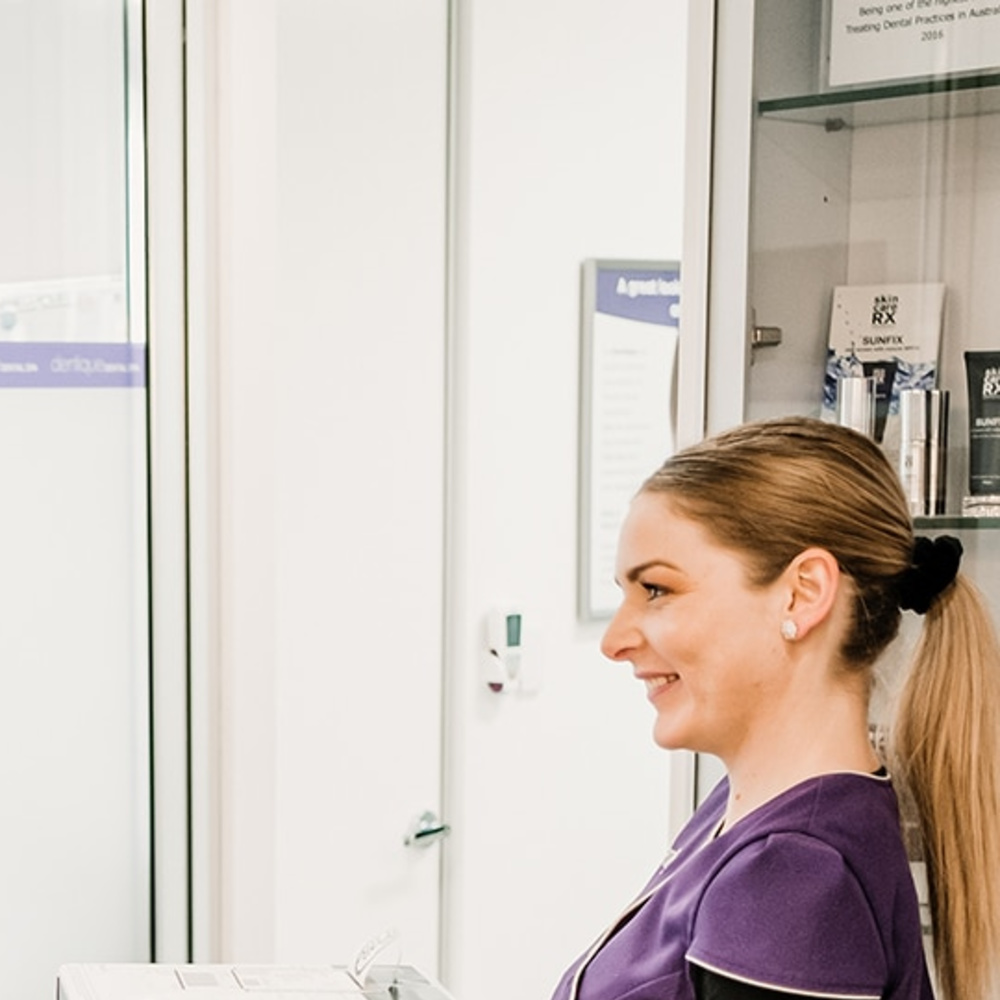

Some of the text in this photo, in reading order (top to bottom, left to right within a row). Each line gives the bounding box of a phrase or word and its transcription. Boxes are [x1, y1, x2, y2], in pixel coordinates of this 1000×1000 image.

[858, 5, 883, 17] Being
[885, 4, 902, 12] one
[905, 0, 915, 10] of
[846, 22, 882, 33] Treating
[883, 18, 911, 30] Dental
[915, 12, 955, 25] Practices
[958, 10, 967, 19] in
[615, 276, 628, 295] A
[871, 312, 896, 325] RX
[862, 336, 904, 346] SUNFIX
